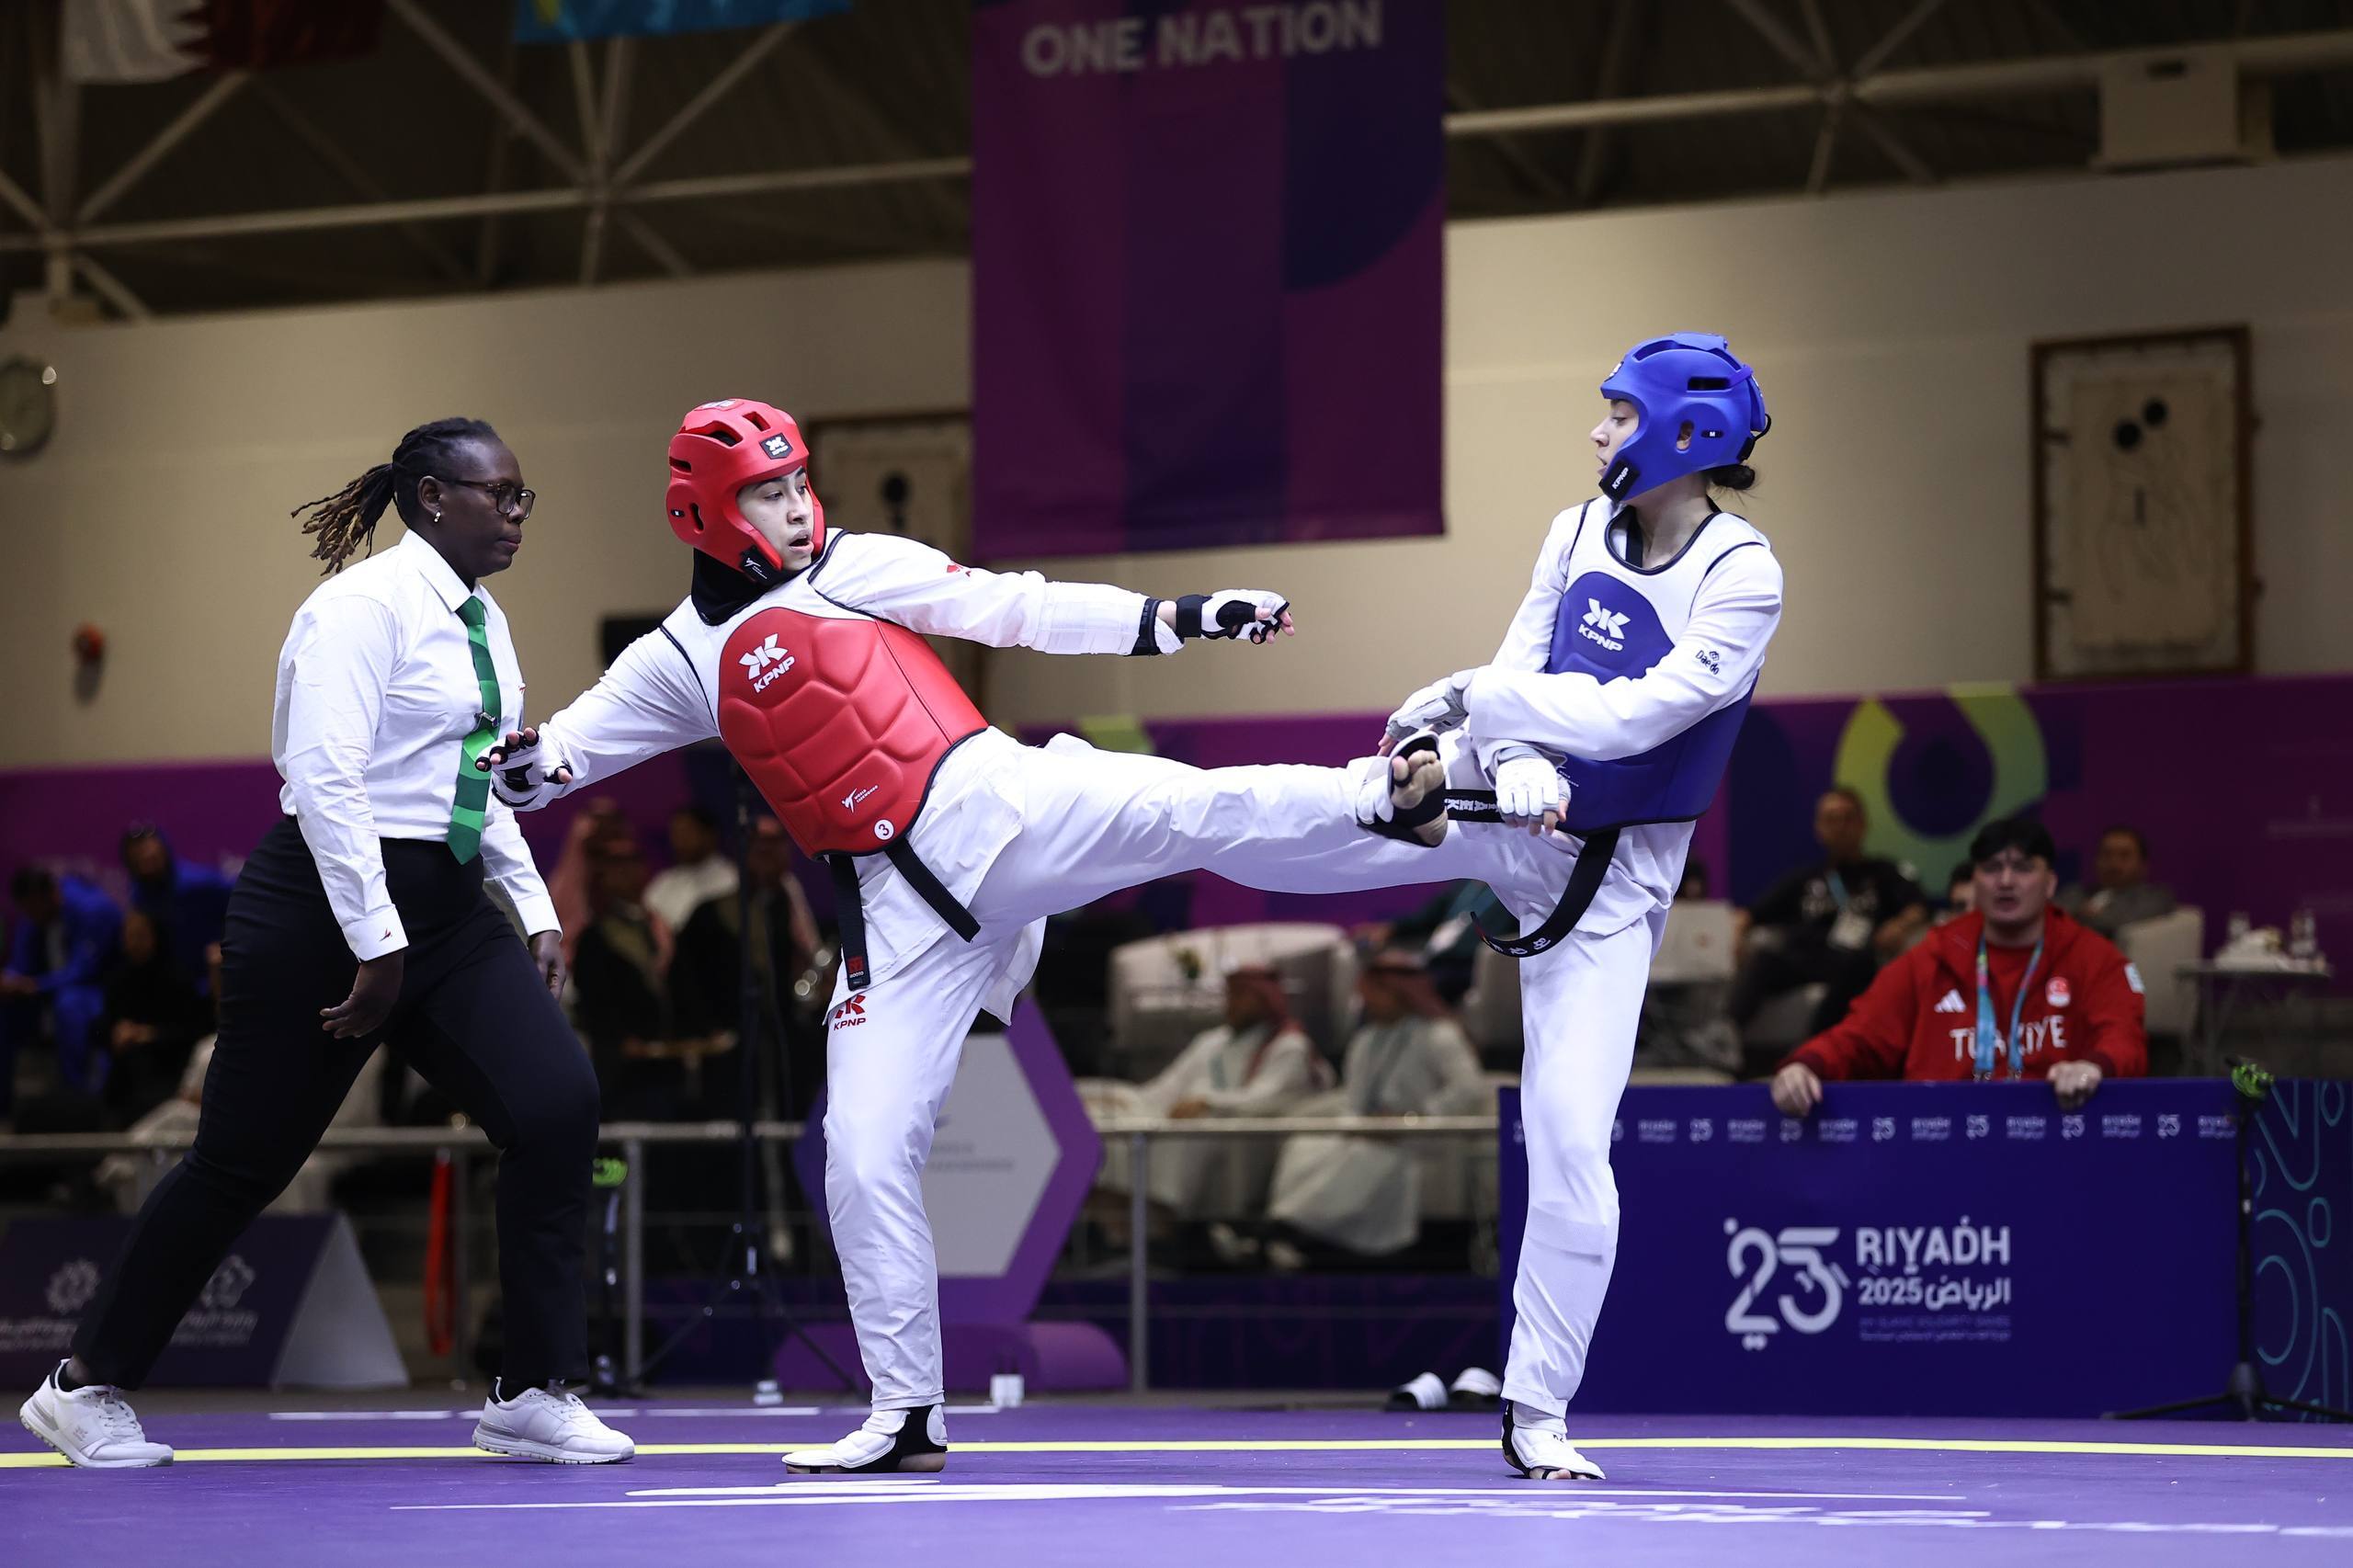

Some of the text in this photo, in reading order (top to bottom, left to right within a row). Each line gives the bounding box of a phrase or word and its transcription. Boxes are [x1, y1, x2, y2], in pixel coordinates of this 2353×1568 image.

[1022, 0, 1383, 77] ONE NATION
[1611, 467, 1629, 490] KPNP
[1578, 623, 1624, 652] KPNP
[754, 655, 795, 694] KPNP
[1695, 650, 1720, 676] Daedo
[878, 824, 890, 836] 3
[834, 1017, 867, 1031] KPNP
[1855, 1221, 2011, 1269] RIYADH
[1858, 1276, 2012, 1311] 2025 الرياض
